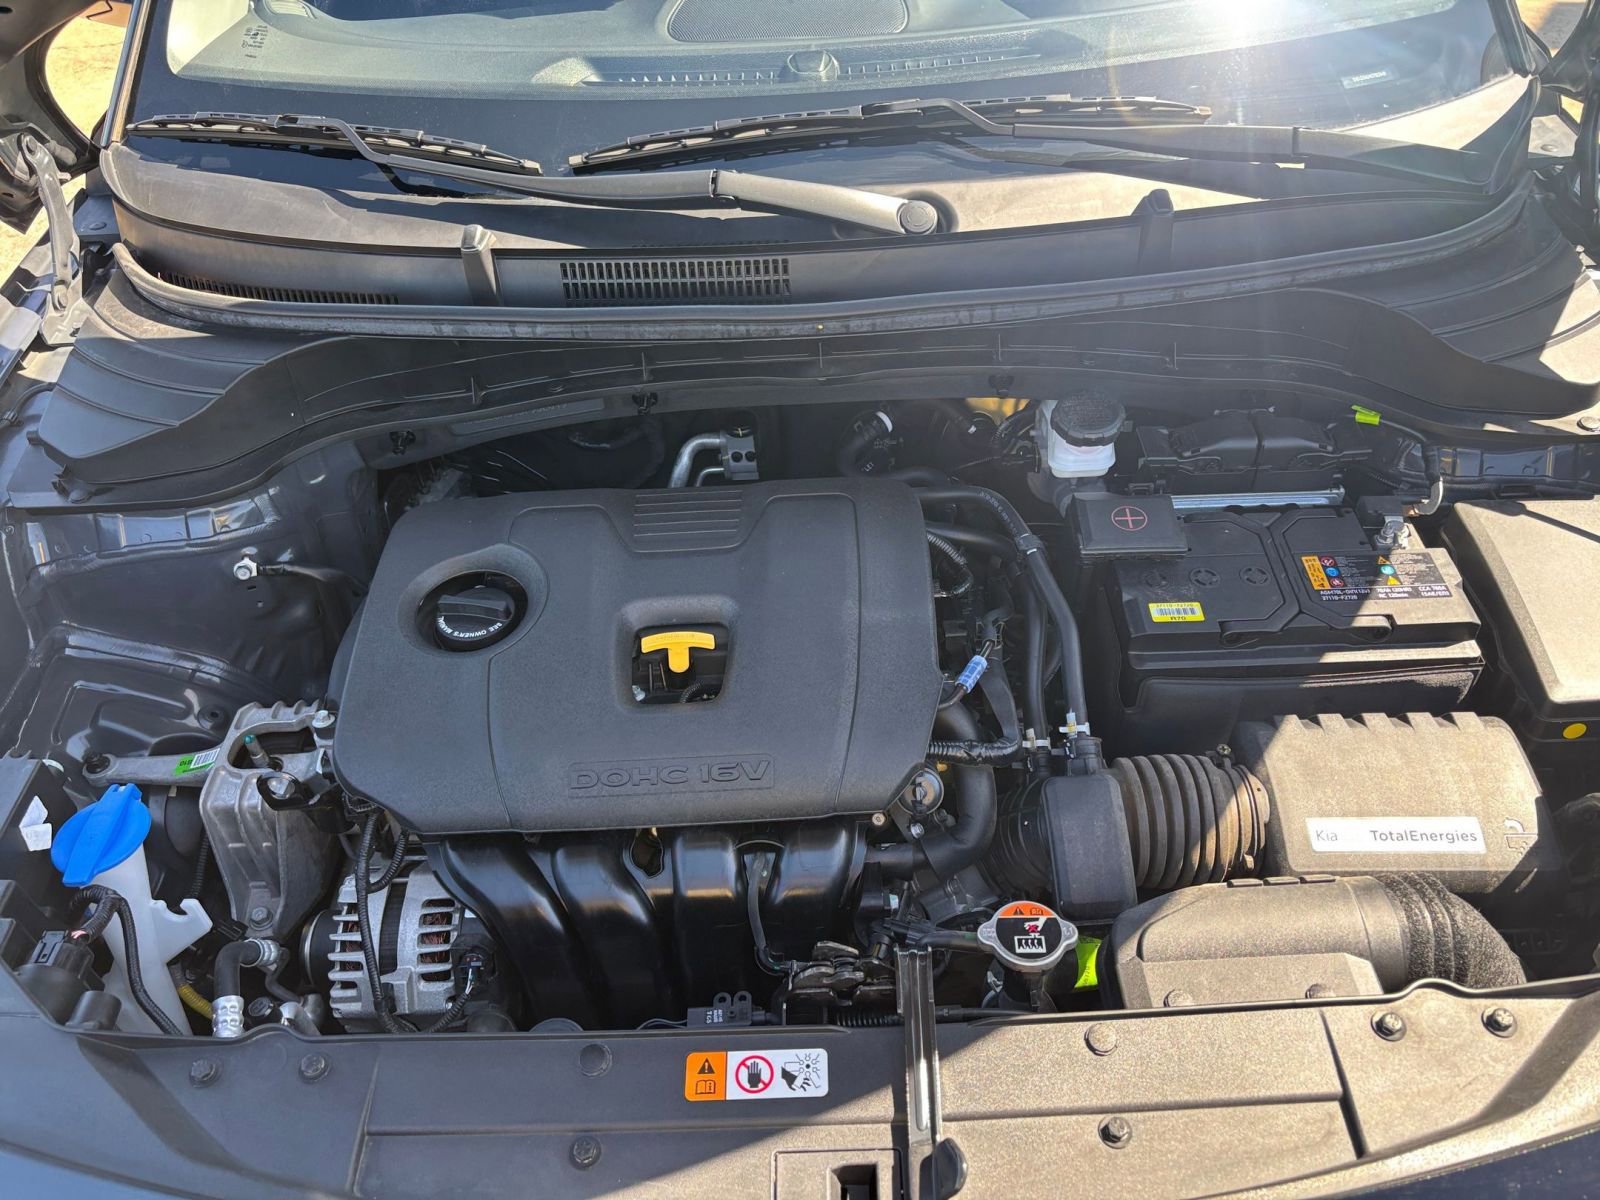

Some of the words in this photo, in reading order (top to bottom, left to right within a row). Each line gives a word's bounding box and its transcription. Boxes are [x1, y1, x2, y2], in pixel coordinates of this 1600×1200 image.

[488, 622, 503, 632] SEE
[570, 765, 689, 790] DOHC
[700, 760, 770, 784] 16V
[1316, 830, 1338, 842] Kia
[1369, 829, 1478, 844] TotalEnergies
